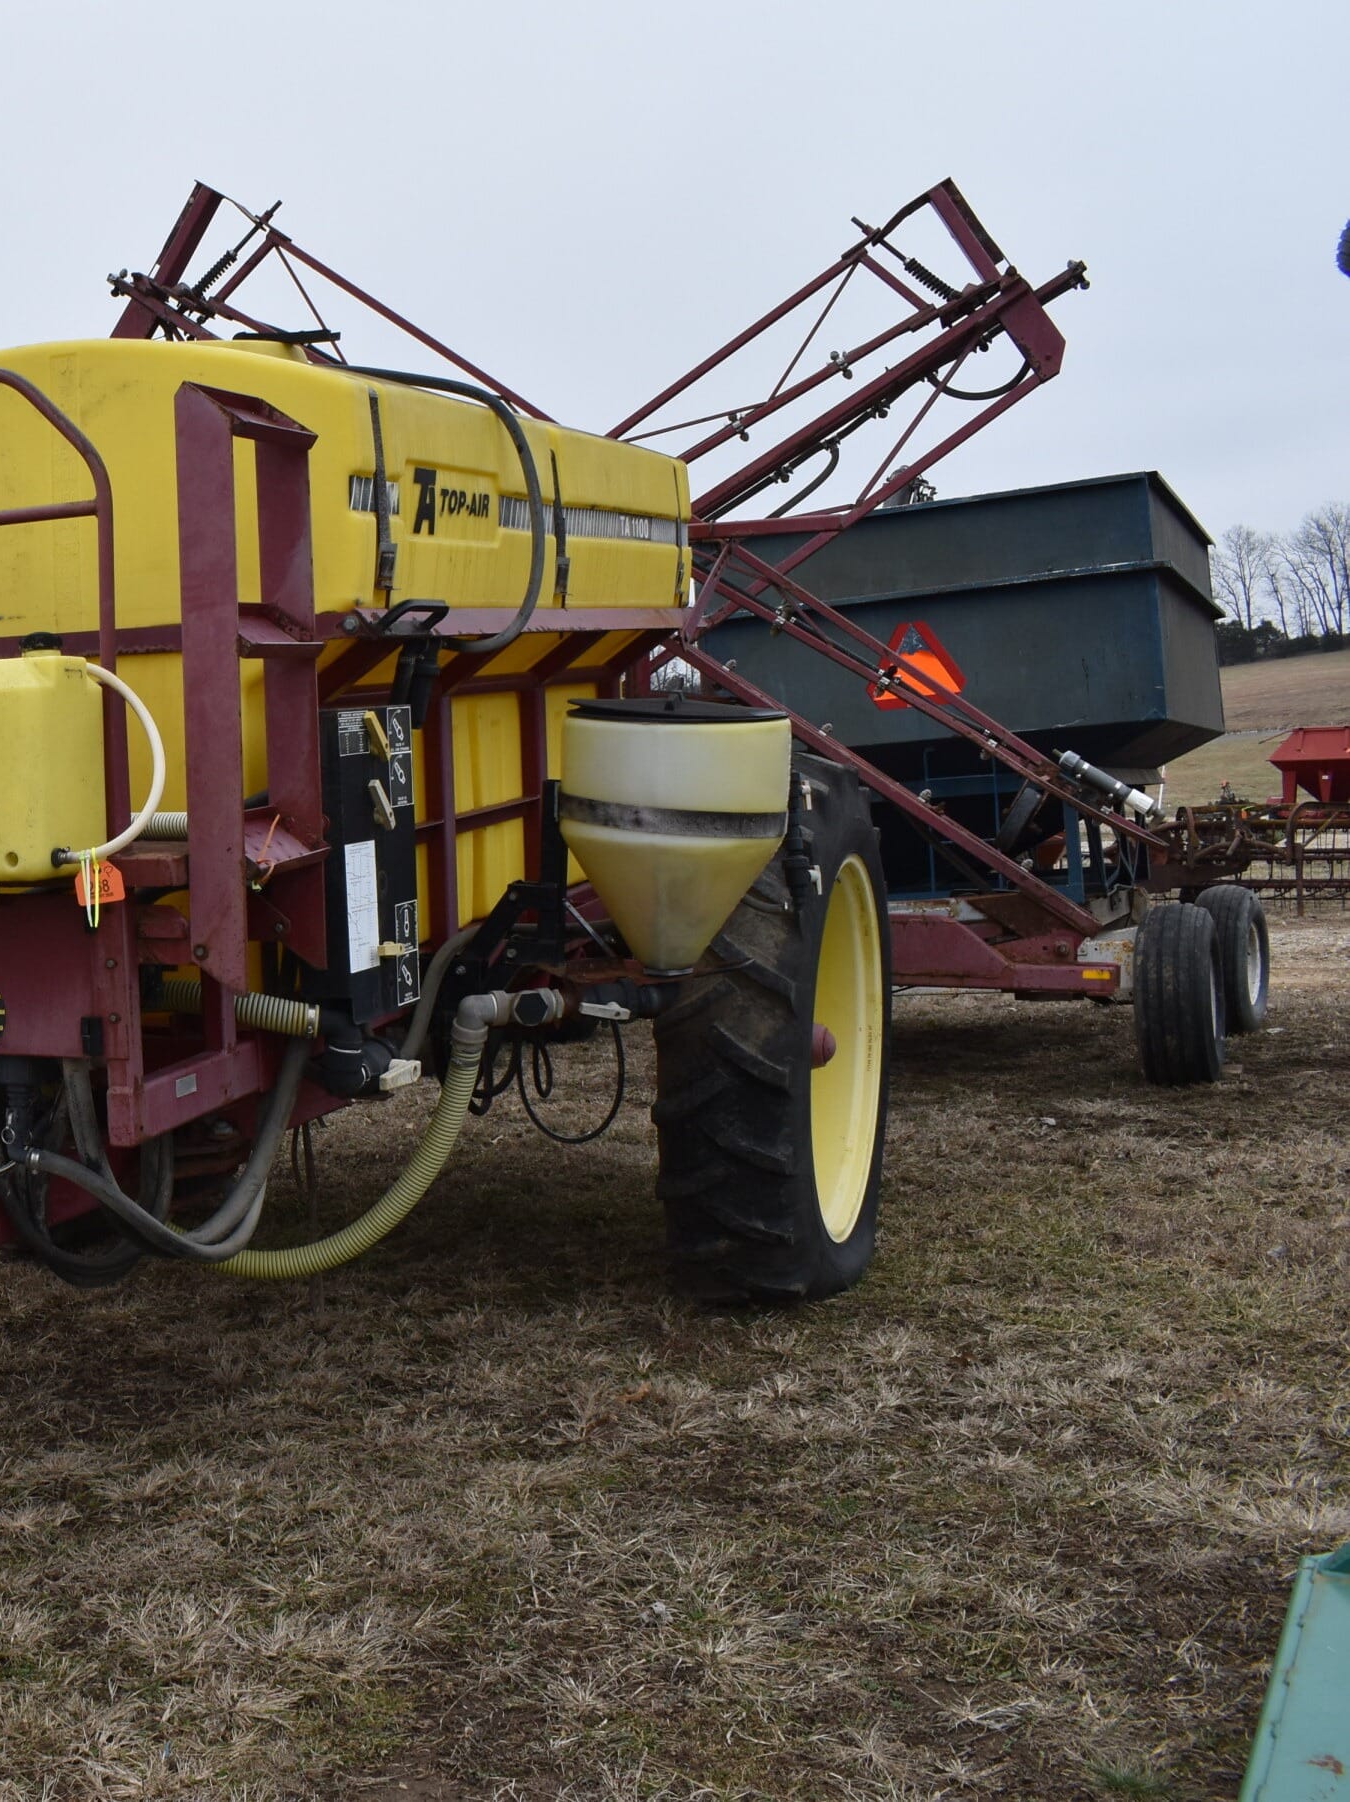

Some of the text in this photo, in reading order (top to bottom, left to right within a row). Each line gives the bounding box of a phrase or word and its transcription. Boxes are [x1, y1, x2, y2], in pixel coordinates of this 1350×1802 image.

[439, 488, 490, 518] TOP-AIR
[619, 515, 649, 539] TA 1100
